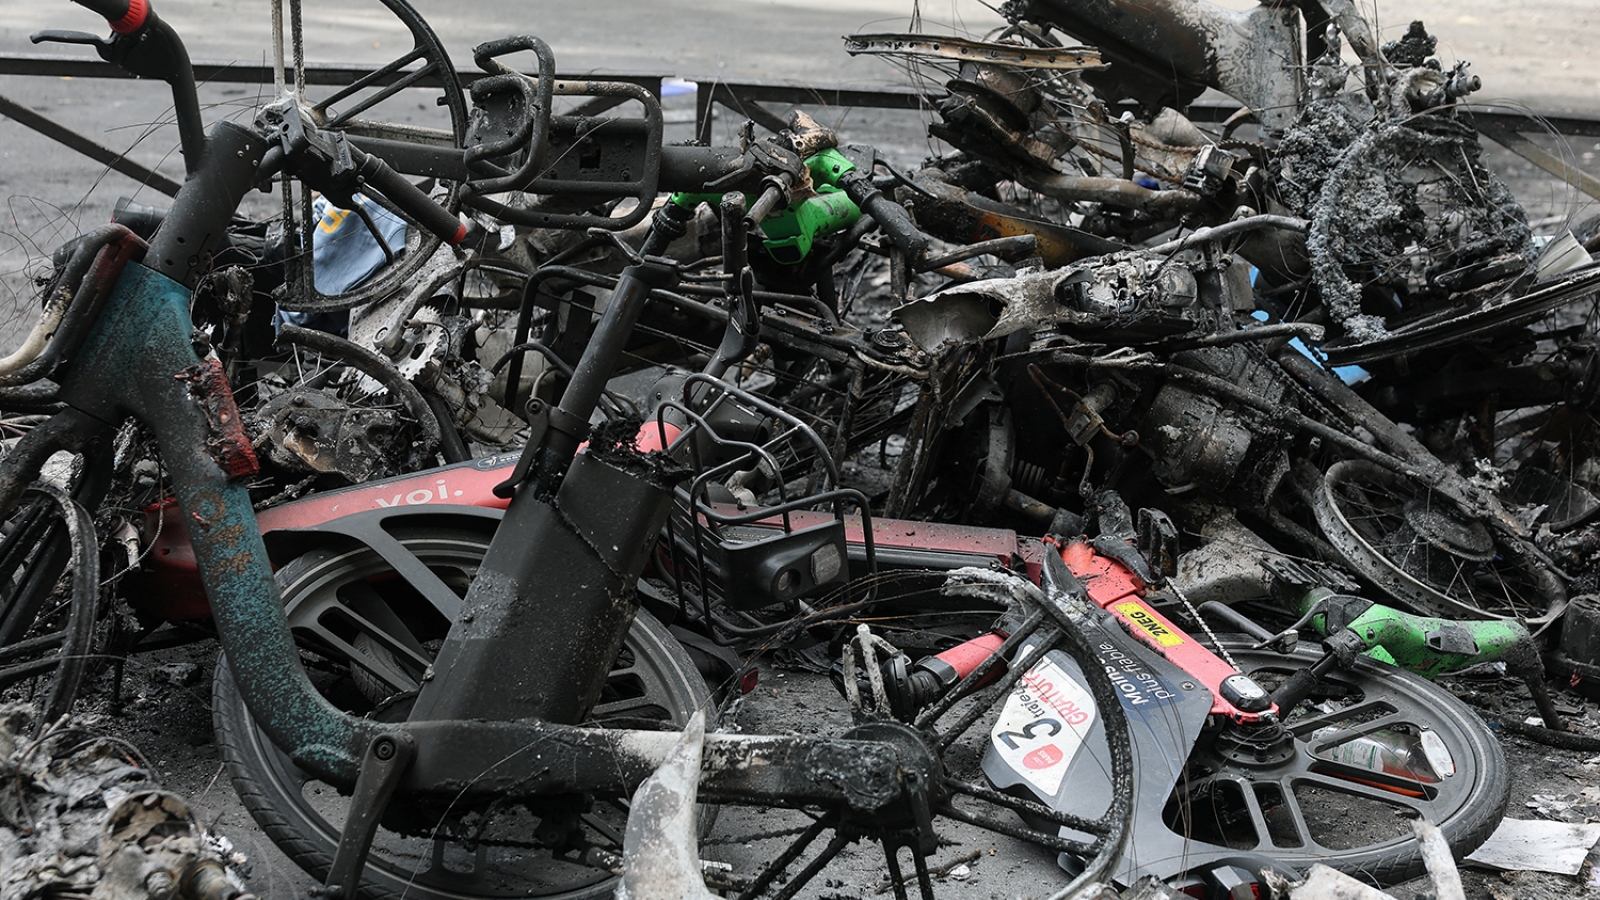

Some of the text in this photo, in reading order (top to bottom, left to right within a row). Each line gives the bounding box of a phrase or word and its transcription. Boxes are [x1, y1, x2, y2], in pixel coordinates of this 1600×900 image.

[375, 479, 464, 508] voi.
[1129, 611, 1169, 637] 2NEG
[1105, 665, 1150, 705] Moins
[1136, 672, 1176, 699] plus
[997, 718, 1062, 751] 3
[1036, 750, 1056, 764] PARIS
